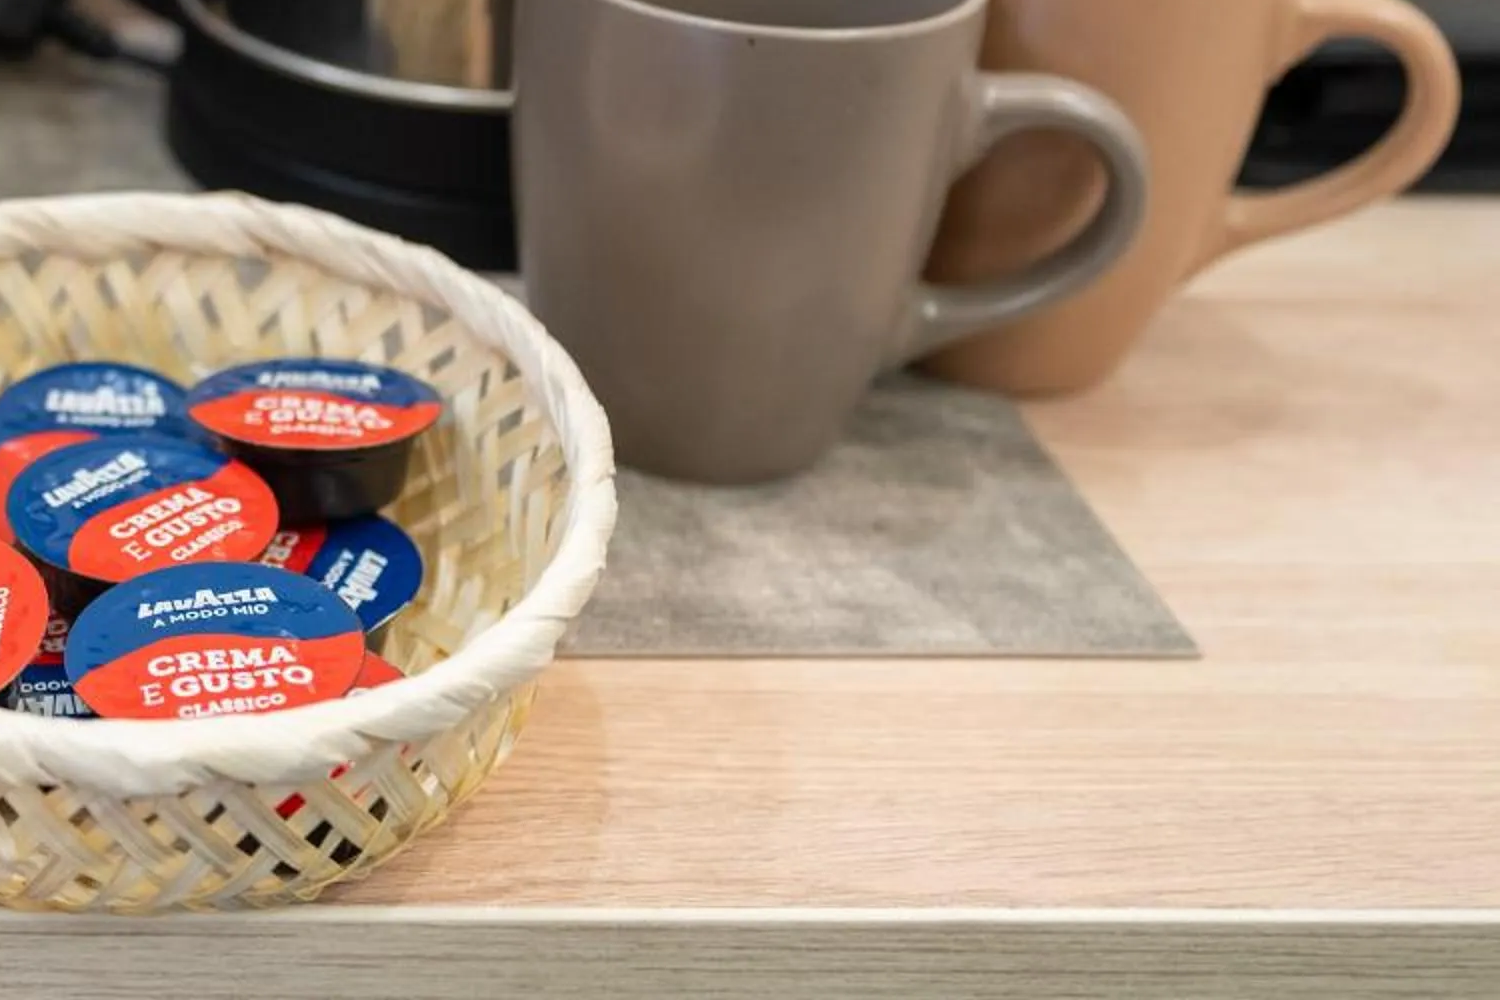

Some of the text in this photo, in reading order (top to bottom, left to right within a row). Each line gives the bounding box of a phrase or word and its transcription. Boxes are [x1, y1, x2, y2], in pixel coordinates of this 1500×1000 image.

[46, 385, 165, 417] LAVAZZA
[42, 451, 147, 507] LAVAZZA
[109, 486, 214, 539] CREMA
[121, 497, 242, 562] E GUSTO
[170, 520, 245, 562] CLASSICO
[337, 549, 388, 610] LAVA
[137, 587, 280, 619] LAVAZZA
[152, 603, 269, 629] A MODO MIO
[147, 645, 297, 678] CREMA
[140, 665, 315, 707] E GUSTO
[177, 692, 288, 719] CLASSICO
